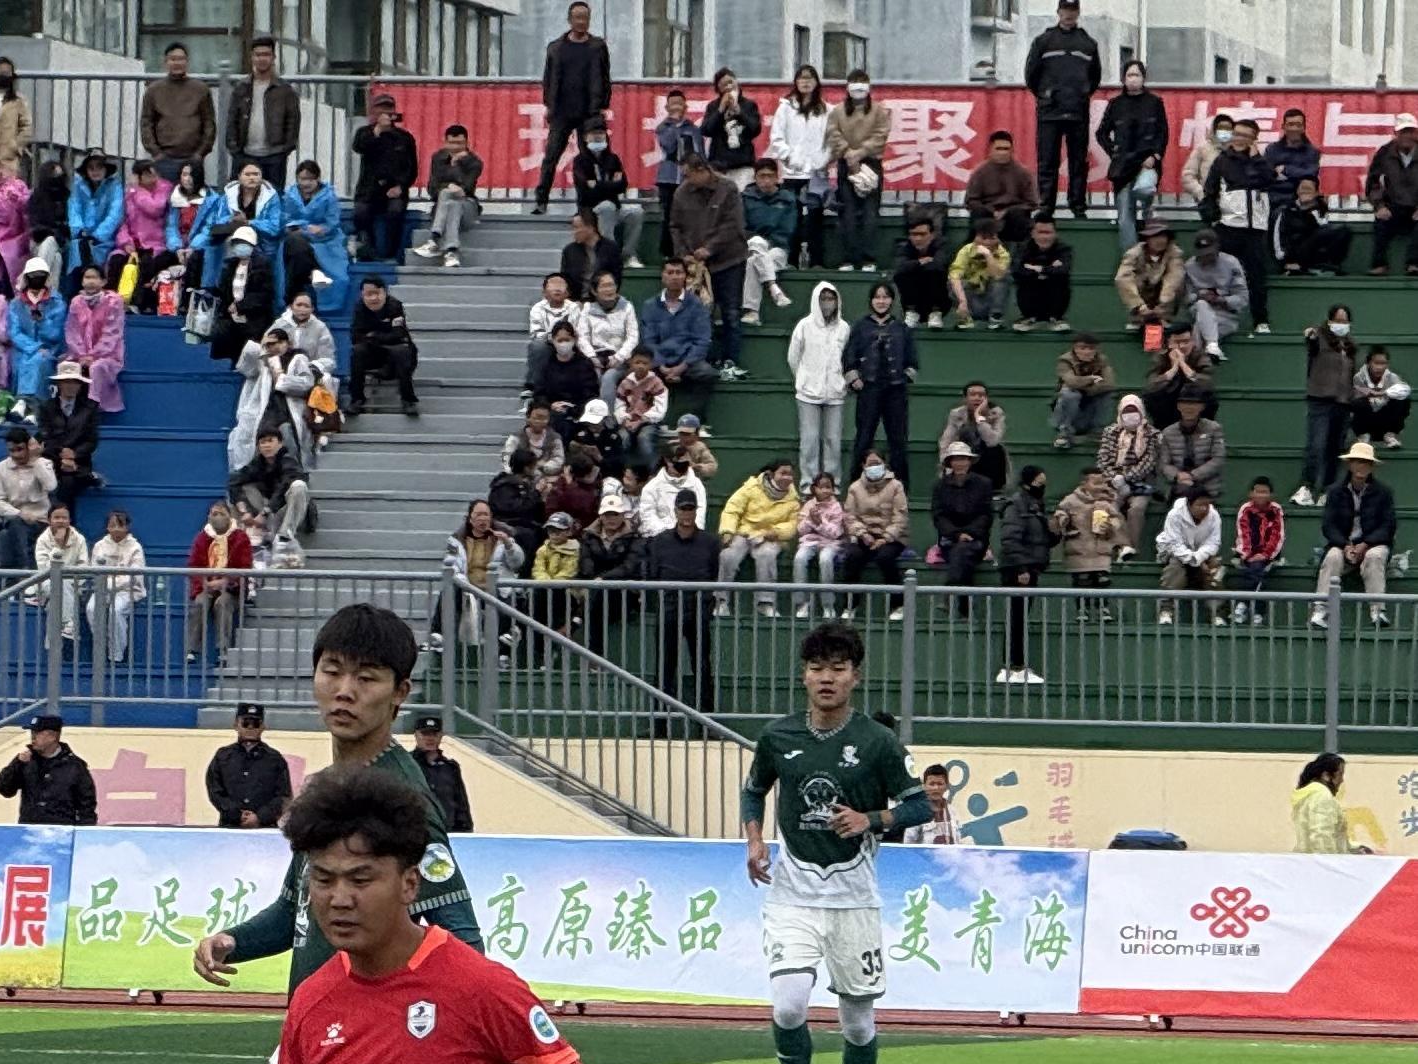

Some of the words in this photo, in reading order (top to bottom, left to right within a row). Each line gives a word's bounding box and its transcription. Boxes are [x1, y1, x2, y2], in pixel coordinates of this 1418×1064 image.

[1119, 925, 1178, 941] China
[1121, 941, 1194, 955] unicom
[1195, 943, 1261, 957] 中国联通
